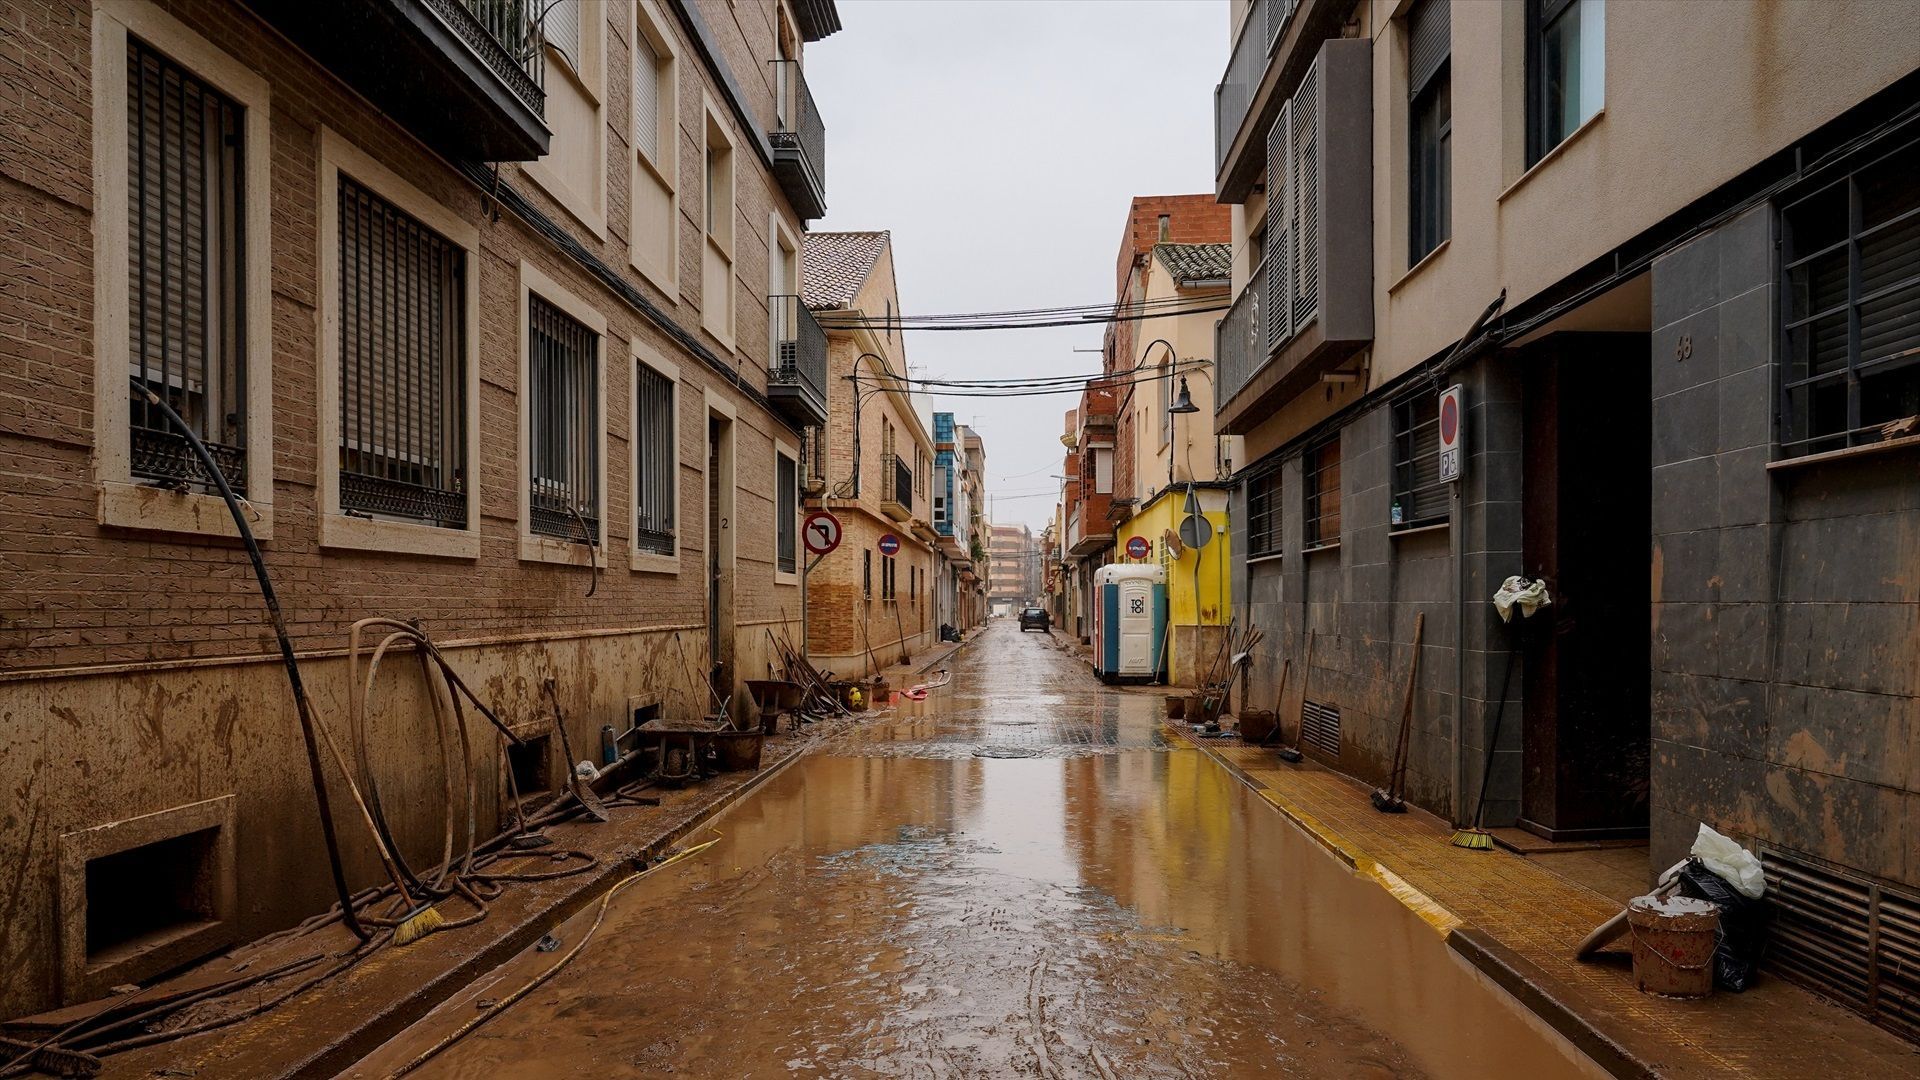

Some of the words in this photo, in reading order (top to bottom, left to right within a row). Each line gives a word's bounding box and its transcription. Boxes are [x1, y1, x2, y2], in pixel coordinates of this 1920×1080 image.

[1675, 335, 1693, 362] 68
[1443, 456, 1448, 475] P
[721, 518, 729, 529] 2
[1131, 606, 1144, 614] TOI
